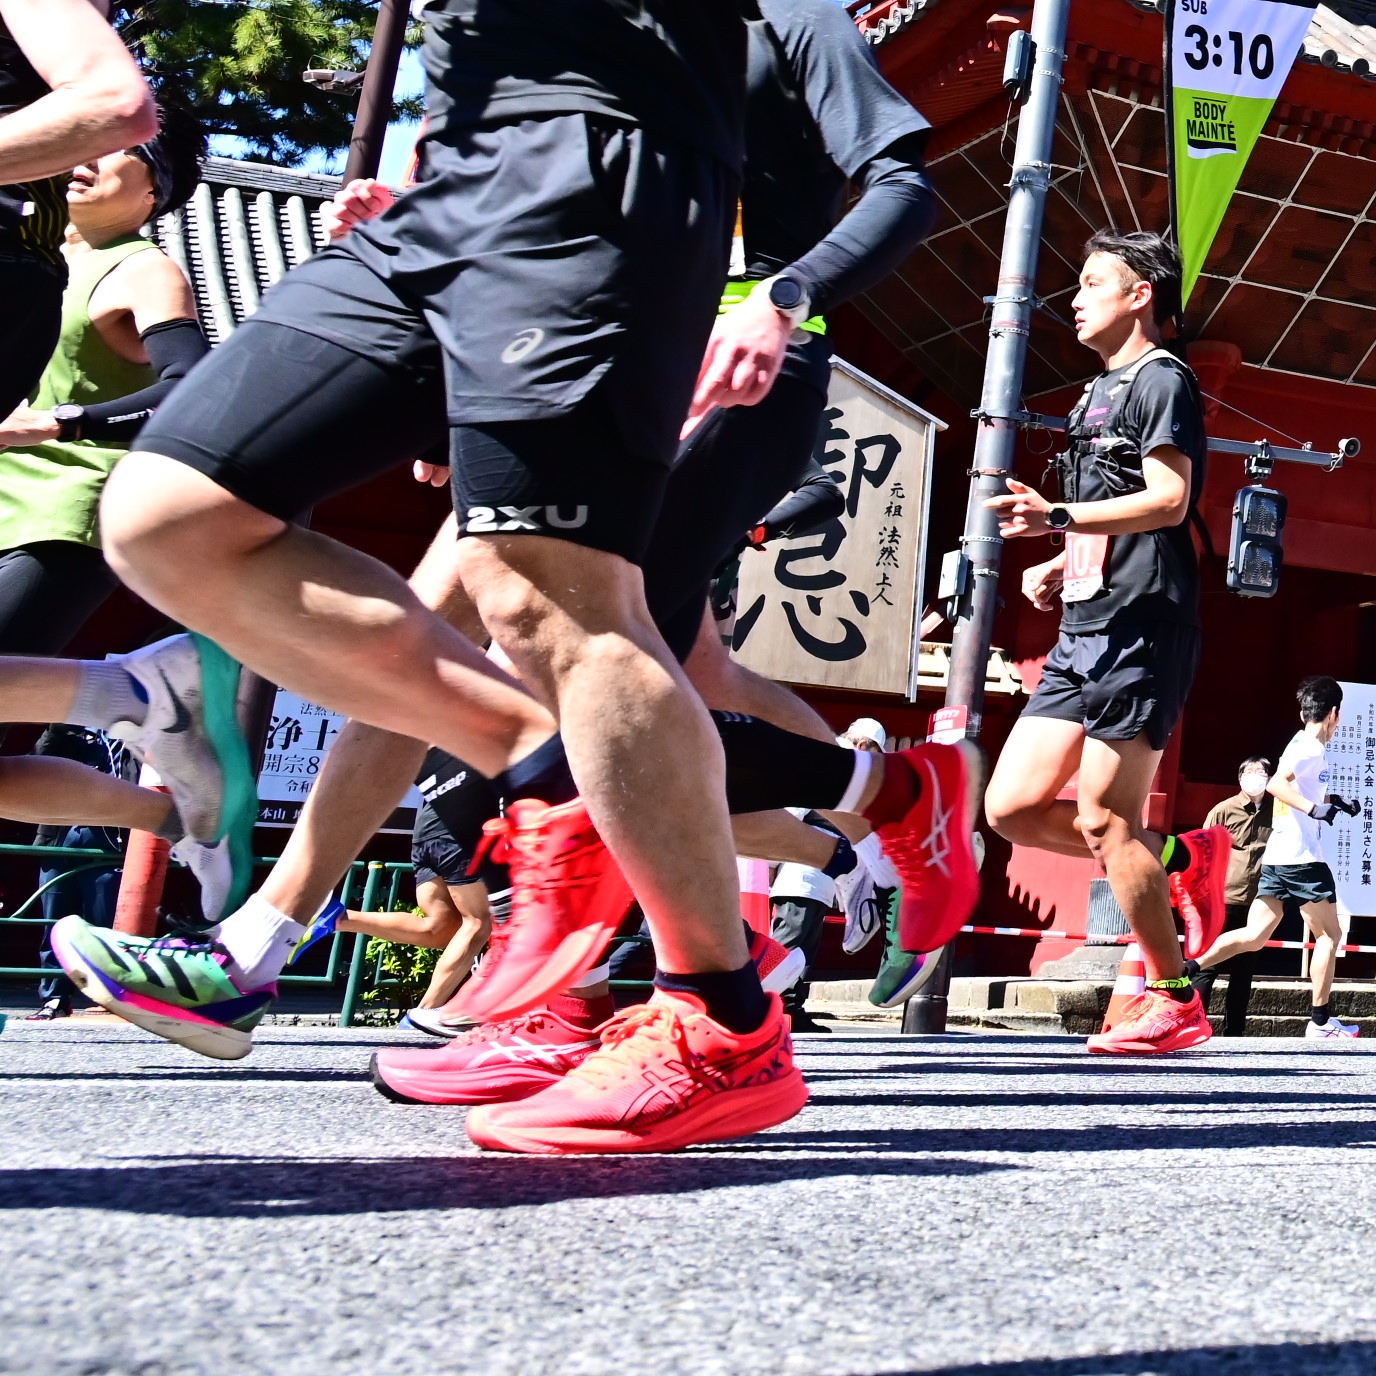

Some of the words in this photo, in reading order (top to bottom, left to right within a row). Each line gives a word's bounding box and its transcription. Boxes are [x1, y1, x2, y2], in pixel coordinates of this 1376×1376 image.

[1184, 24, 1274, 80] 3:10
[1194, 100, 1226, 122] BODY
[1186, 120, 1236, 142] MAINTÉ
[466, 505, 589, 532] 2XU
[267, 715, 338, 751] 浄土
[1364, 736, 1376, 787] 御忌大会
[286, 779, 313, 793] 令和
[256, 807, 287, 821] 本山
[1361, 795, 1374, 885] お稚児さん募集
